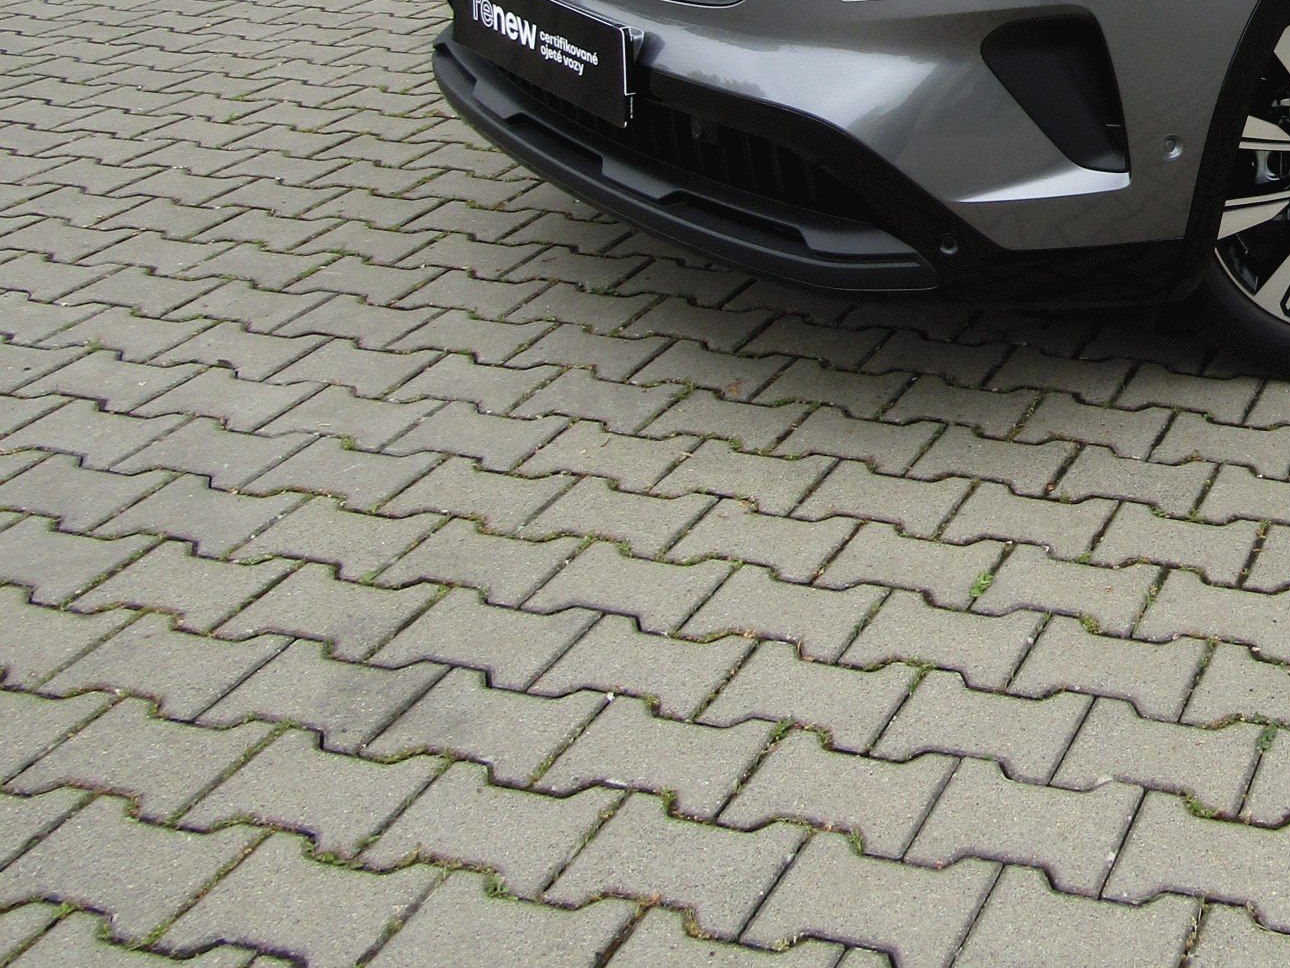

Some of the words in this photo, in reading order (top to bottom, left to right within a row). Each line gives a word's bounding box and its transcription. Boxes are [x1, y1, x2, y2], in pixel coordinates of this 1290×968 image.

[540, 31, 599, 66] certifikované
[540, 44, 563, 64] ojeté
[563, 55, 584, 76] vozy
